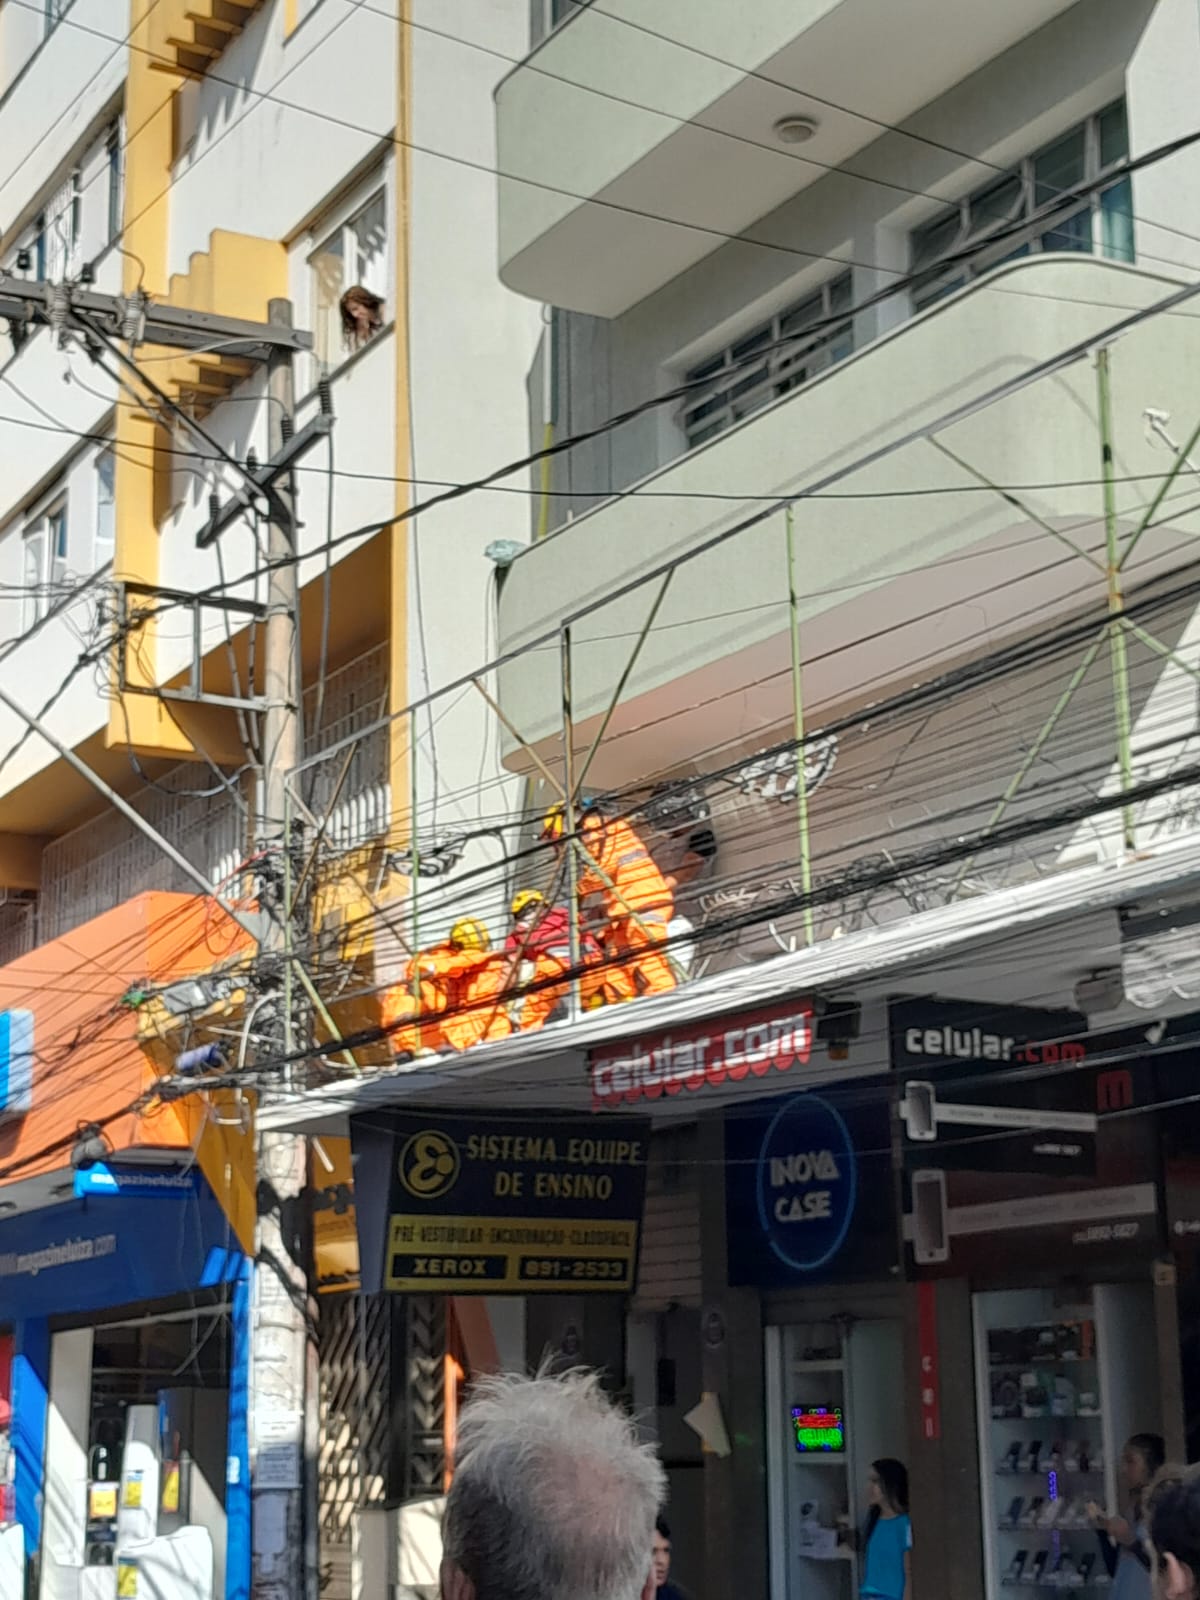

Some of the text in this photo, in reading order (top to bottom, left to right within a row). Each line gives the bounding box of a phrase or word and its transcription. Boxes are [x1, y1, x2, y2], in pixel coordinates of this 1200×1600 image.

[593, 1013, 811, 1096] celular.com
[466, 1134, 642, 1166] SISTEMA EQUIPE
[494, 1171, 613, 1200] DE ENSINO
[774, 1190, 833, 1223] CASE
[413, 1257, 487, 1276] XEROX
